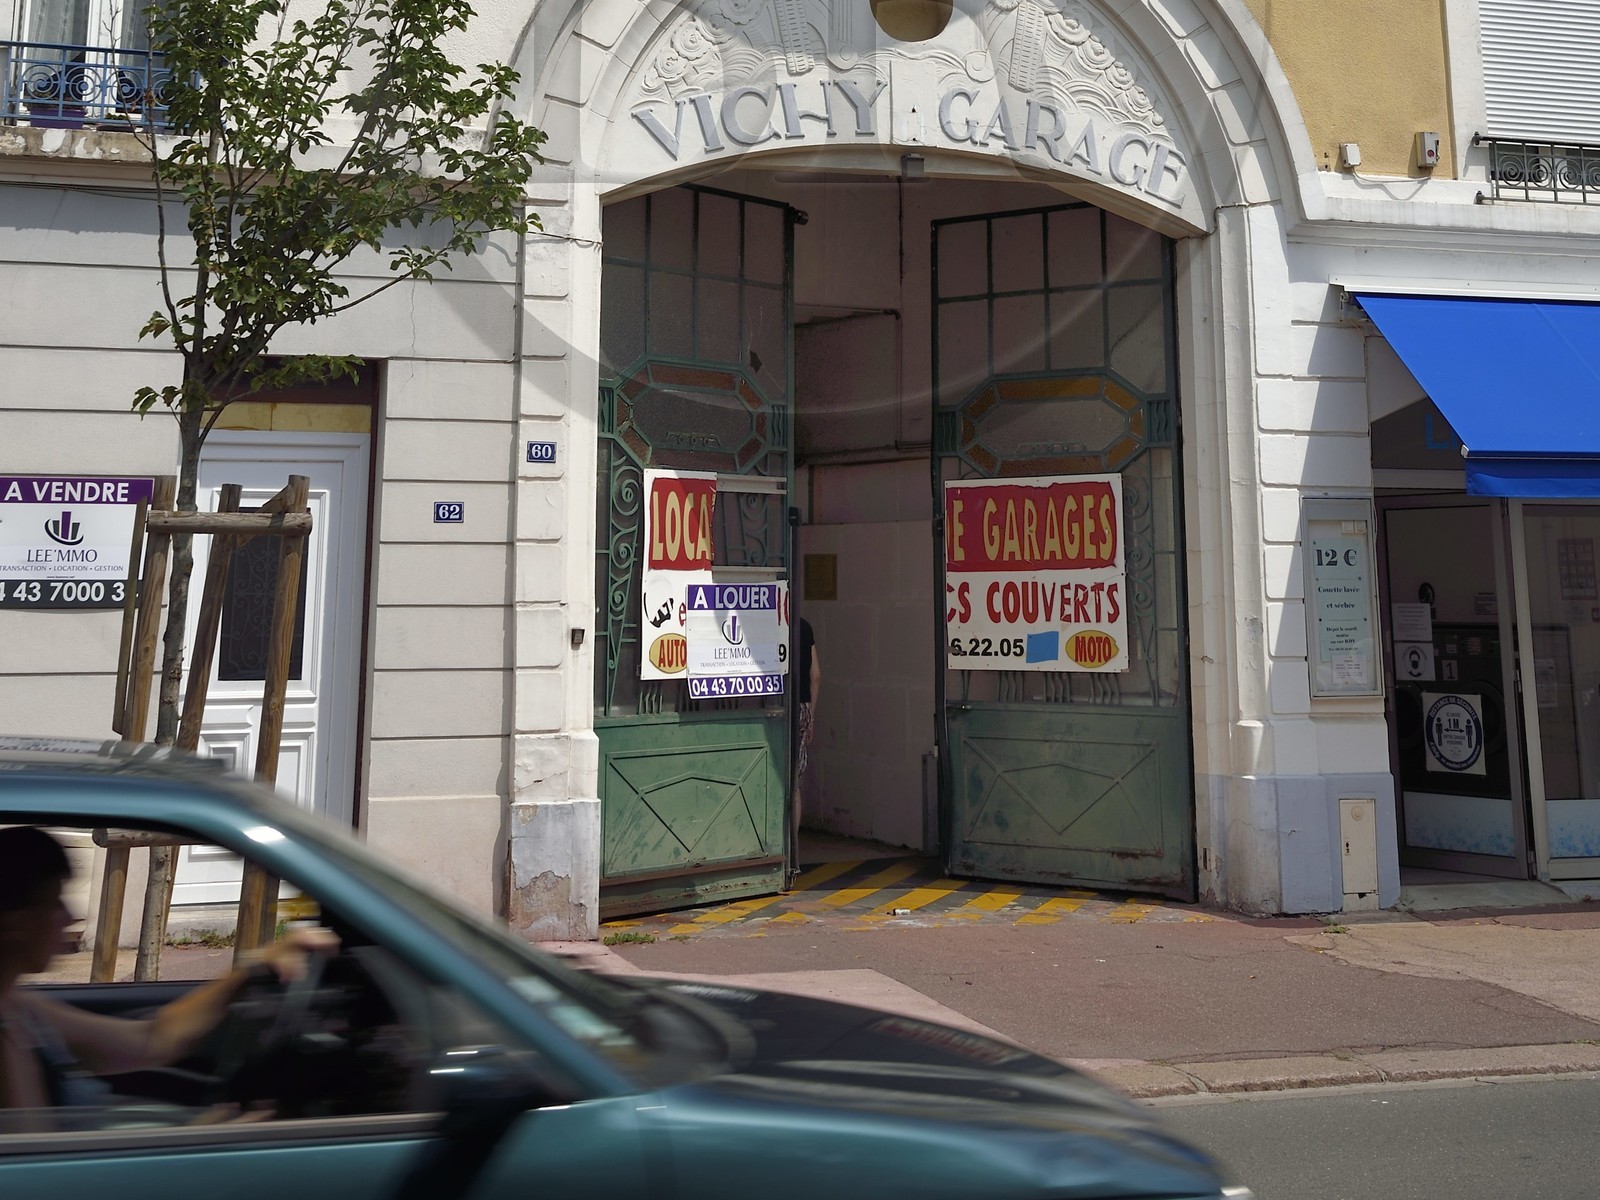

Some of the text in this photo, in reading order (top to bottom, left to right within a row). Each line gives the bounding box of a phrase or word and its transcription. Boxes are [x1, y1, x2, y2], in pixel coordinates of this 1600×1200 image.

[631, 79, 1188, 208] VICHY GARAGE
[531, 444, 552, 459] 60
[4, 481, 130, 503] A VENDRE
[438, 504, 460, 519] 62
[947, 493, 1114, 562] E GARAGES
[1315, 548, 1358, 567] 12 €
[12, 581, 42, 602] 43
[50, 582, 105, 602] 7000
[111, 581, 139, 602] 3
[693, 586, 708, 609] A
[715, 586, 770, 609] LOUER
[986, 581, 1120, 624] COUVERTS
[658, 639, 687, 668] AUTO
[1074, 636, 1112, 663] MOTO
[692, 676, 780, 696] 04 43 70 00 35
